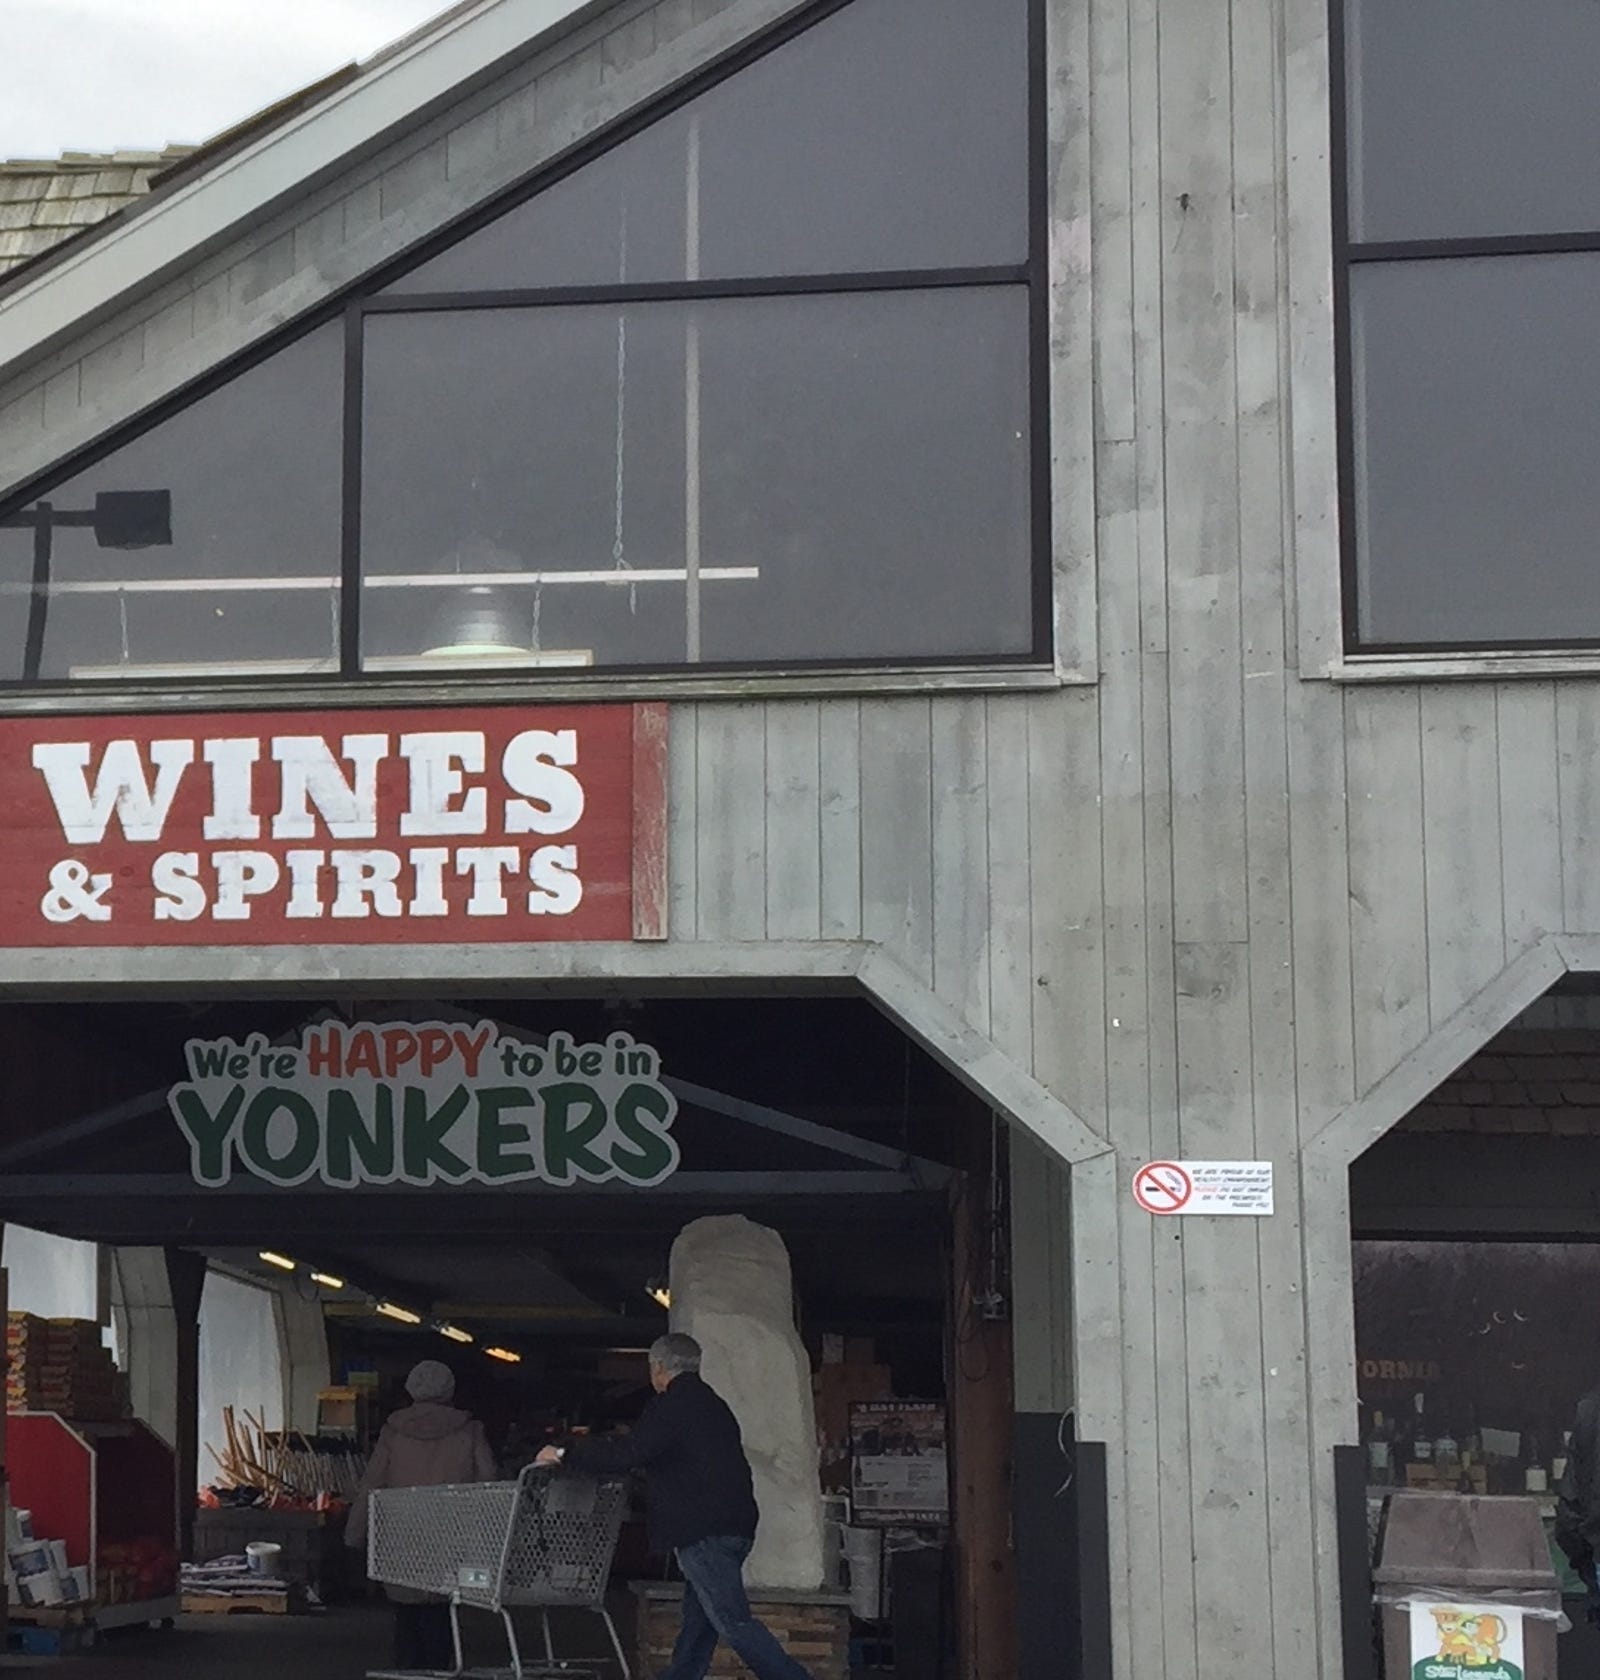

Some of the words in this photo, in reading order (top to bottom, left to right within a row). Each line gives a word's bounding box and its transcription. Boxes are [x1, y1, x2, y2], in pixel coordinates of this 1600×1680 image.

[32, 730, 584, 843] WINES
[41, 859, 112, 922] &
[152, 844, 583, 921] SPIRITS
[192, 1039, 297, 1079] We're
[307, 1027, 490, 1079] HAPPY
[500, 1045, 543, 1077] to
[556, 1039, 602, 1077] be
[615, 1039, 651, 1076] in
[176, 1082, 673, 1182] YONKERS
